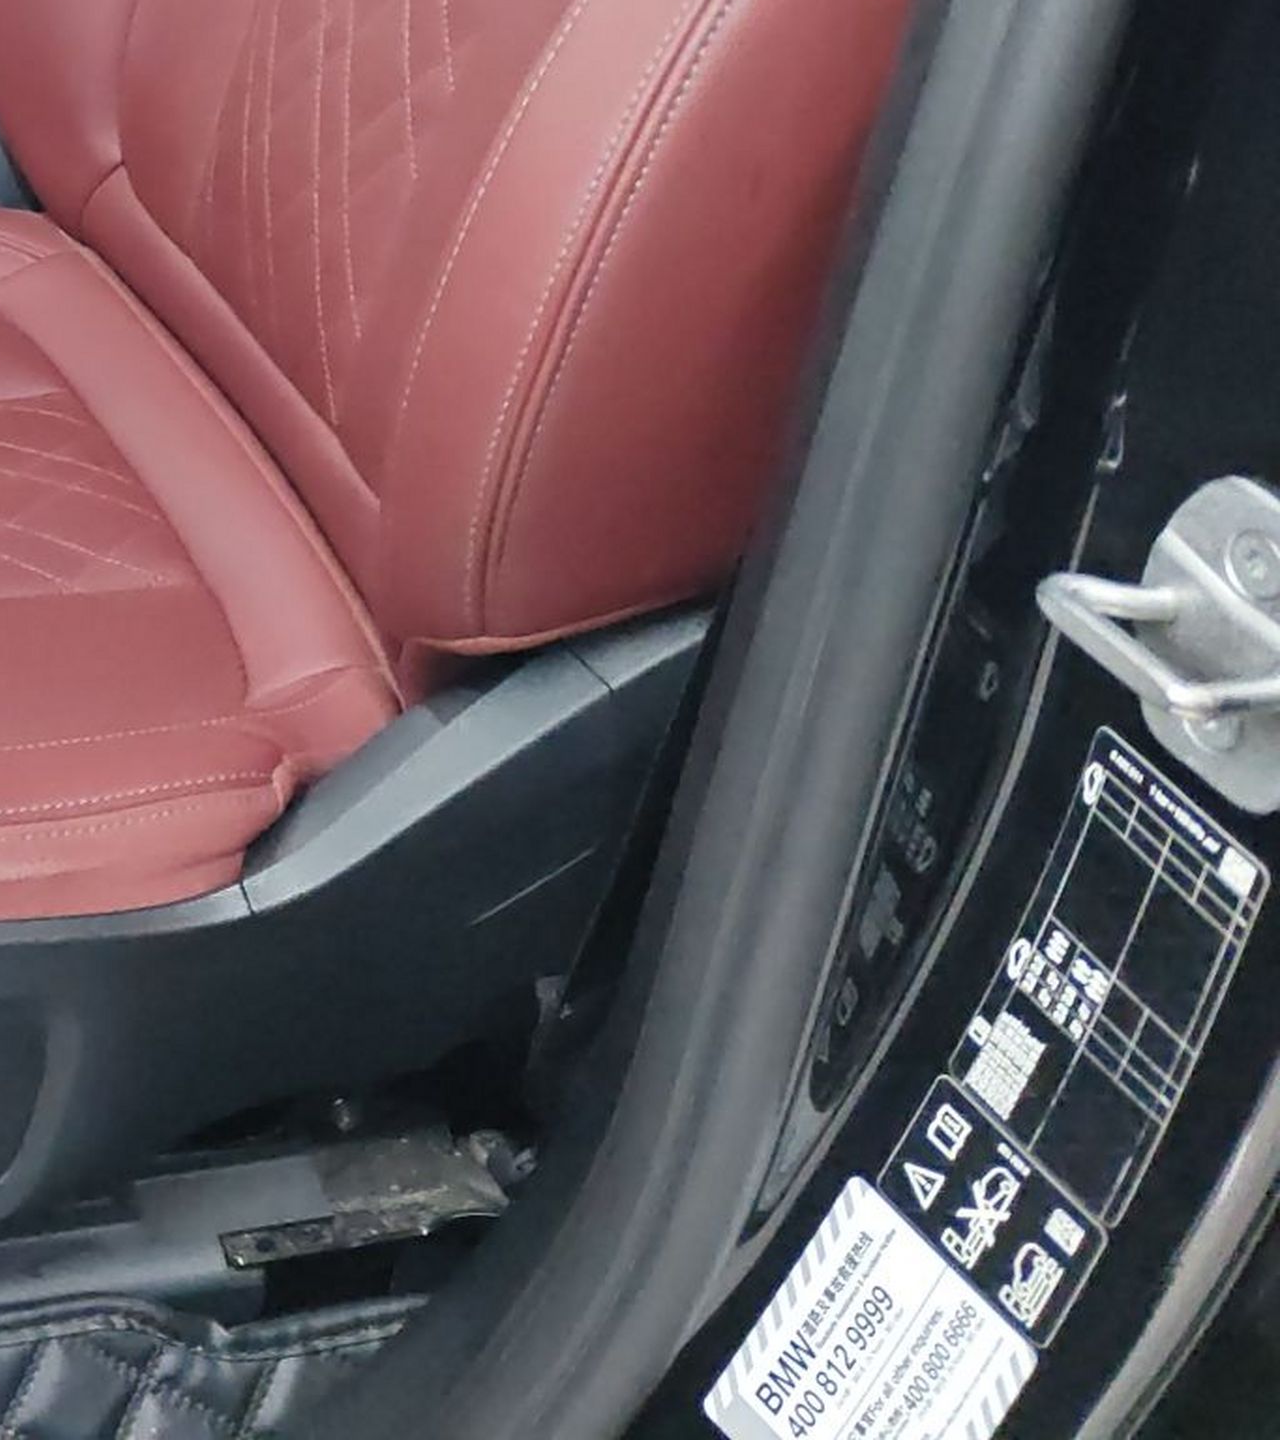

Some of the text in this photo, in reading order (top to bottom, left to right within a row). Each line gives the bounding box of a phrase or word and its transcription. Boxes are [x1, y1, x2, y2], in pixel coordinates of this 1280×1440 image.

[755, 1329, 816, 1415] BMW
[787, 1389, 825, 1439] 400
[816, 1343, 857, 1396] 812
[846, 1285, 893, 1351] 9999
[902, 1375, 930, 1410] 400
[921, 1342, 951, 1380] 800
[943, 1299, 978, 1348] 6666
